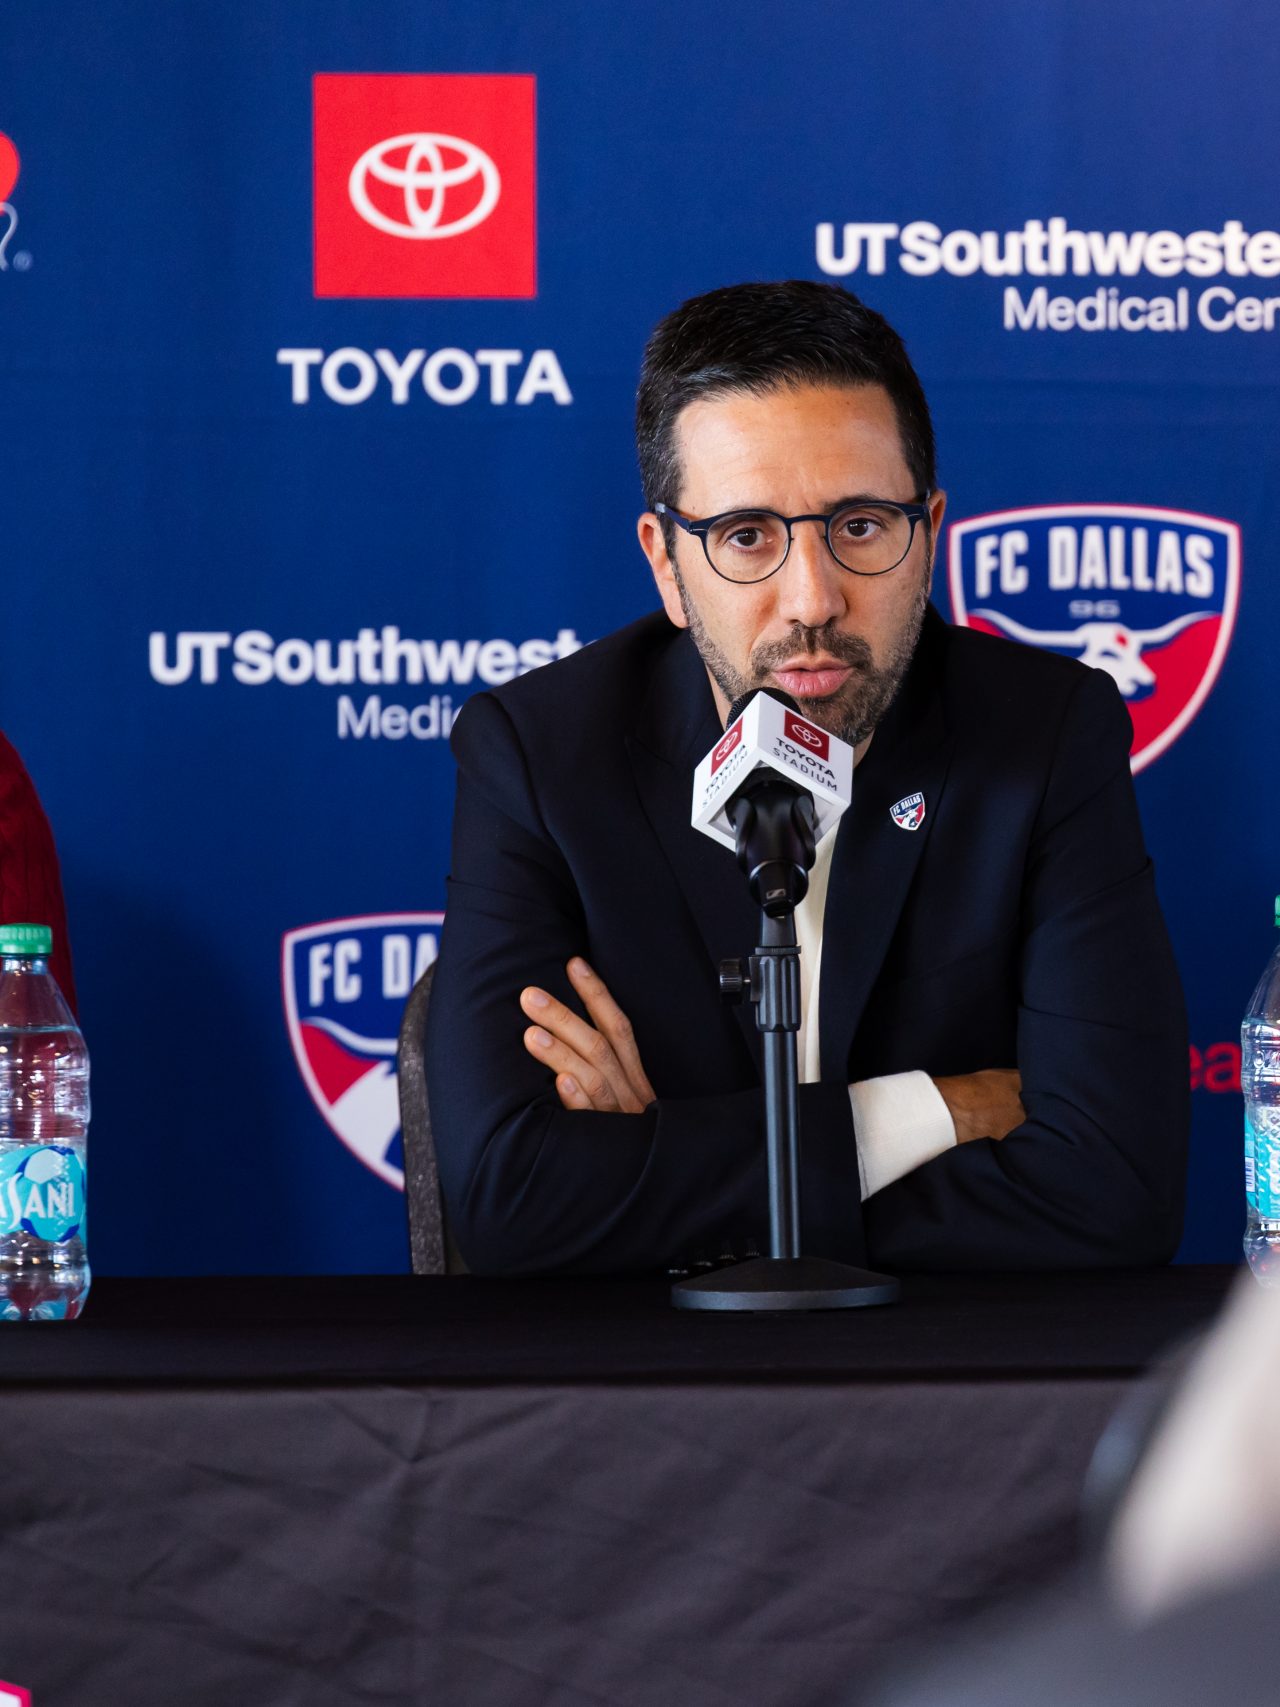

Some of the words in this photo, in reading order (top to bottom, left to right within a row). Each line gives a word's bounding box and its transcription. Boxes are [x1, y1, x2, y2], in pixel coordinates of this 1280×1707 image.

[1002, 286, 1189, 332] Medical
[277, 347, 573, 405] TOYOTA
[974, 529, 1029, 599] FC
[1047, 525, 1215, 598] DALLAS
[1068, 600, 1121, 618] 96
[336, 695, 464, 740] Medi
[773, 747, 837, 791] STADIUM
[776, 737, 835, 779] TOYOTA
[893, 805, 900, 815] FC
[901, 795, 921, 810] DALLAS
[309, 941, 362, 1008] FC
